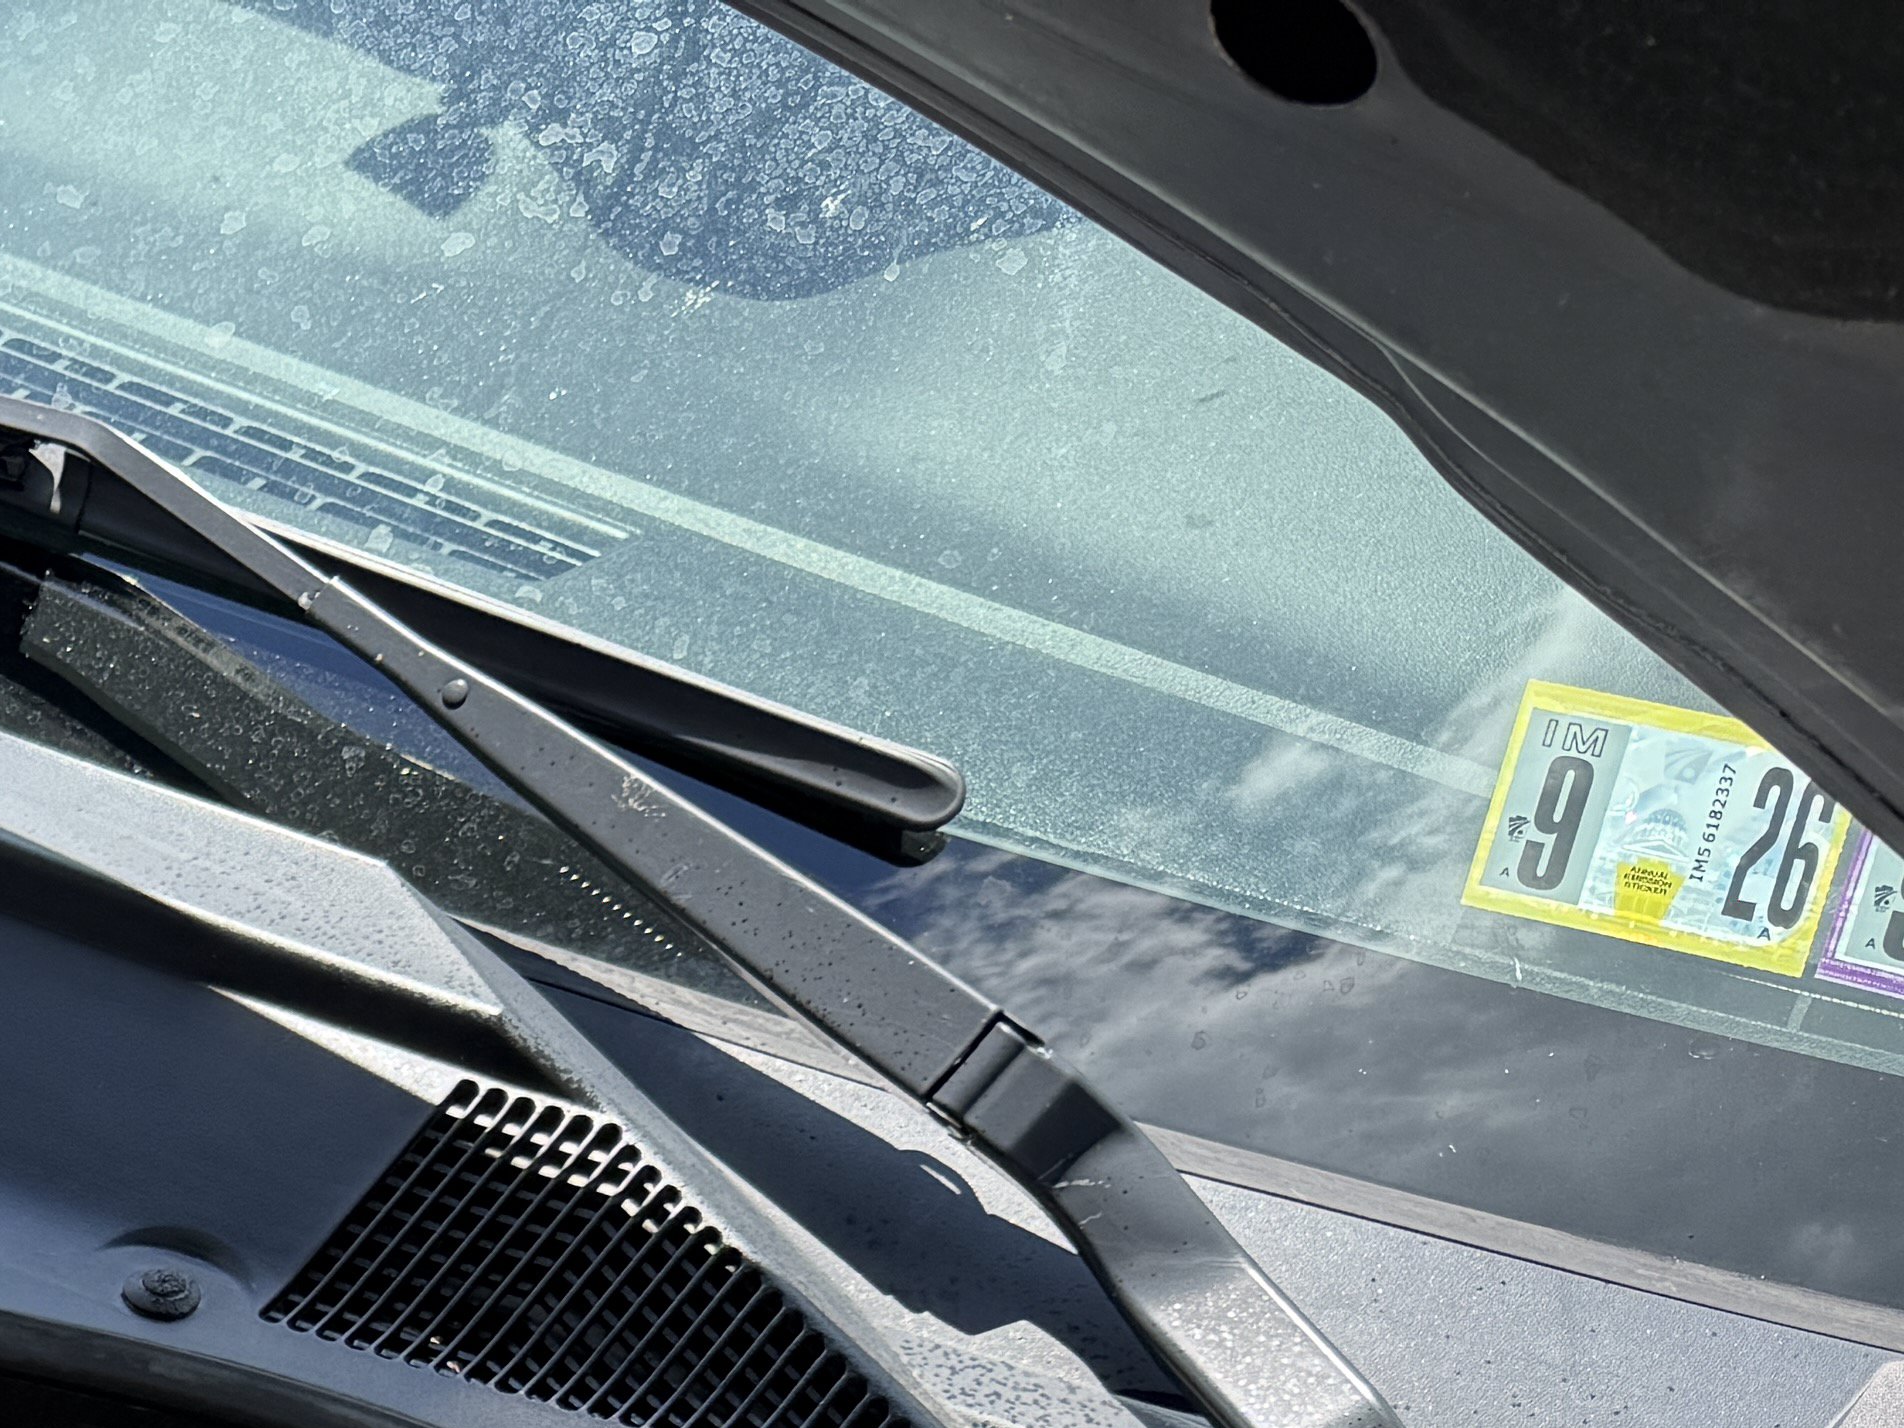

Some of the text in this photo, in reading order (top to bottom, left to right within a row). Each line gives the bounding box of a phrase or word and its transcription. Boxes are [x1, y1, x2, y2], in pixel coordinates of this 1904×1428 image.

[1541, 718, 1610, 758] IM
[1516, 755, 1595, 892] 9
[1702, 762, 1738, 844] 6182337
[1721, 766, 1836, 931] 26
